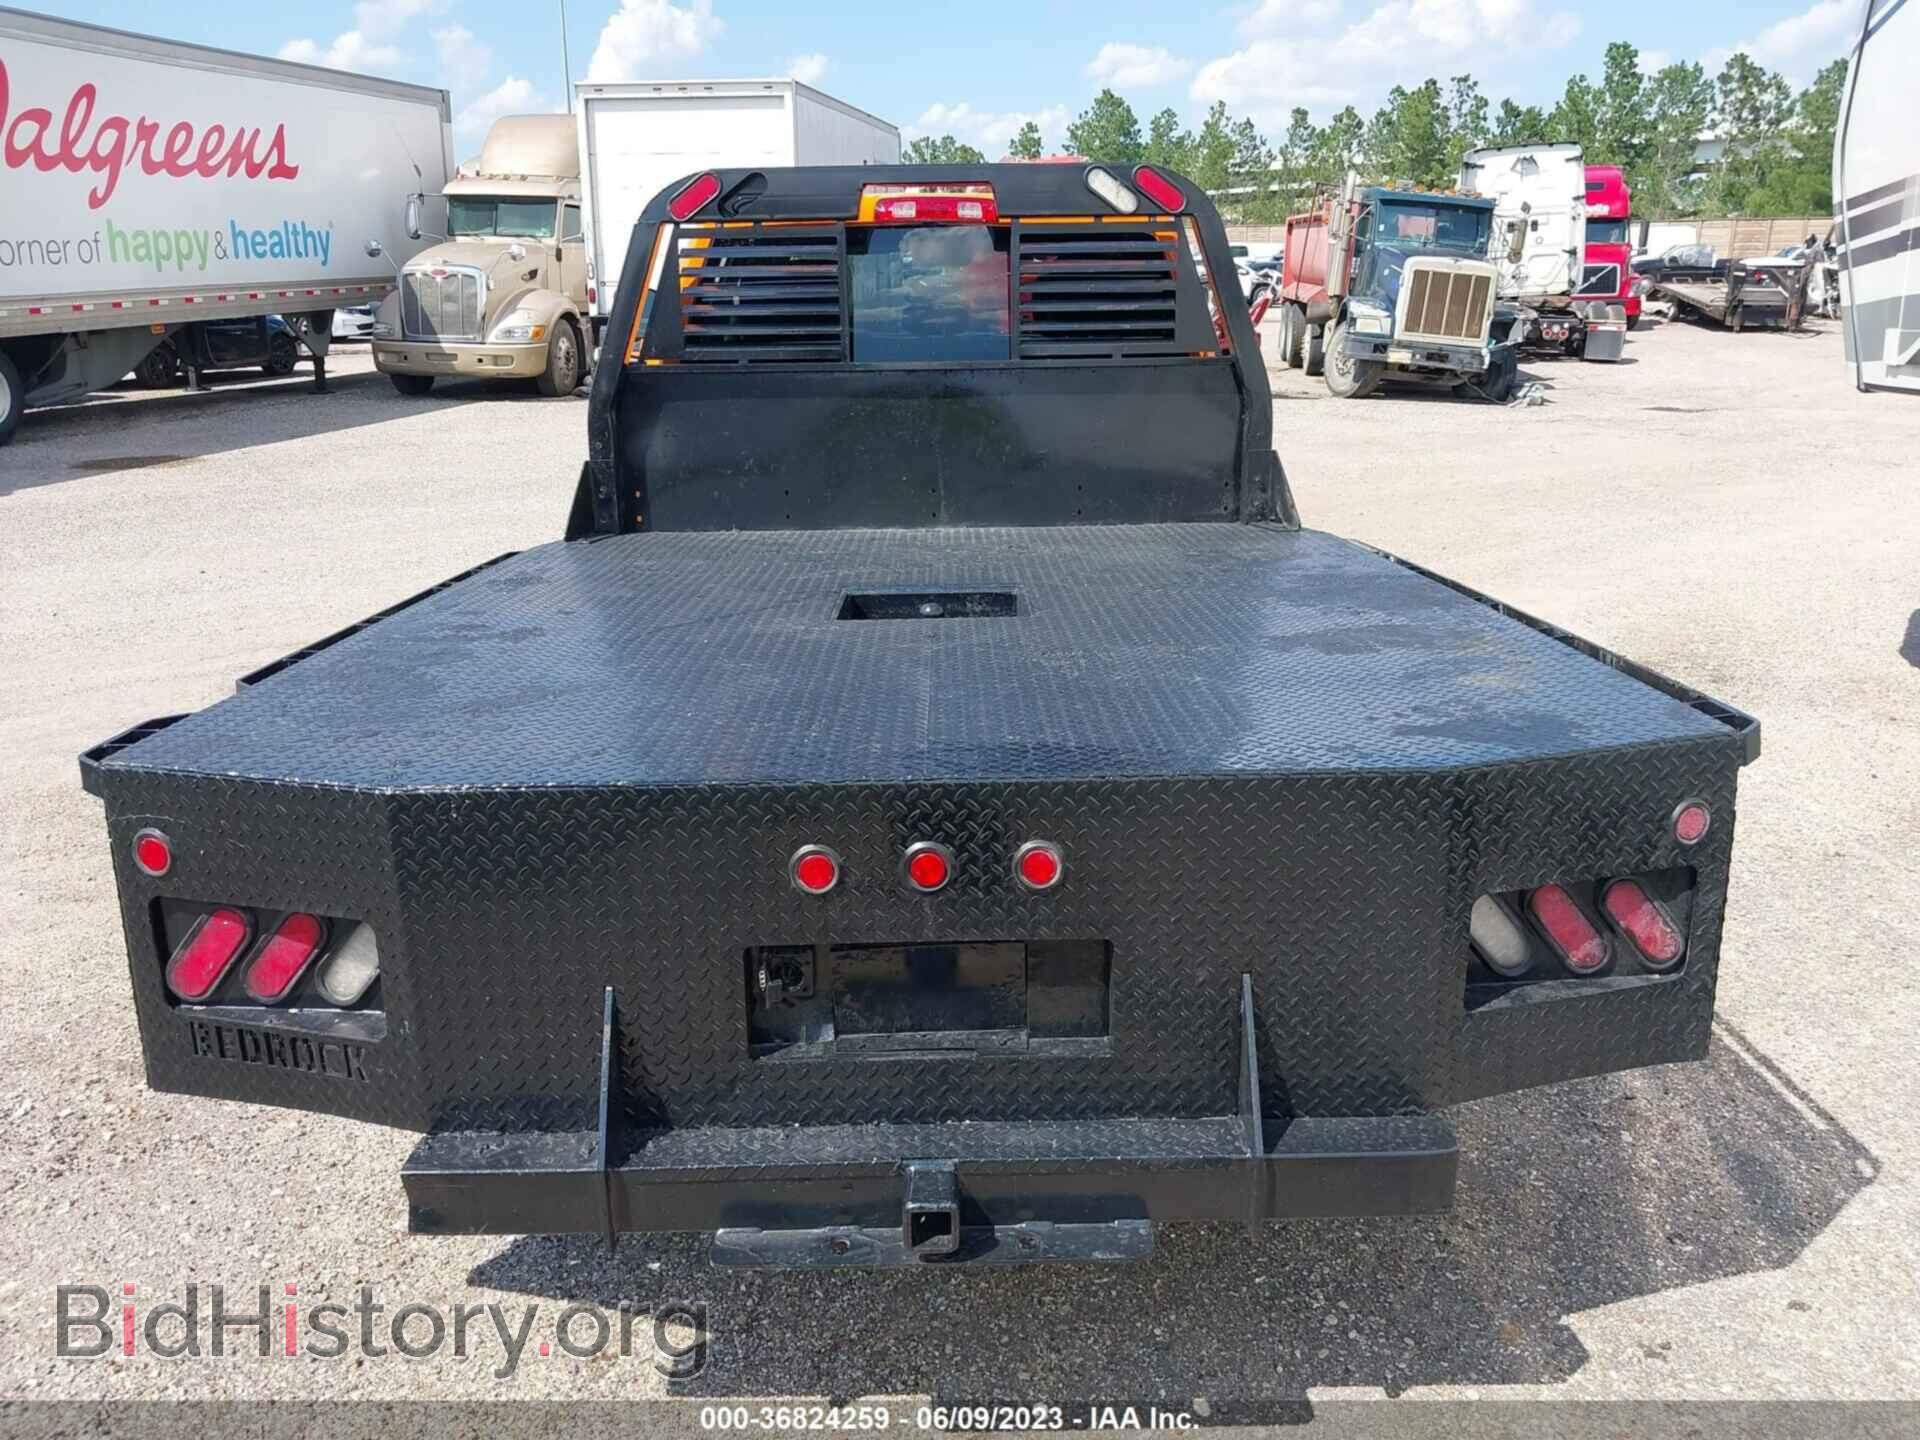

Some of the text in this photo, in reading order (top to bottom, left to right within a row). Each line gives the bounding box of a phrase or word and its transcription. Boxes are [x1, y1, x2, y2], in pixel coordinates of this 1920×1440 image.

[0, 55, 299, 210] algreens
[77, 231, 101, 264] of
[106, 218, 209, 272] happy
[214, 230, 229, 260] &
[230, 219, 330, 266] healthy
[189, 1020, 369, 1083] BEDROCK
